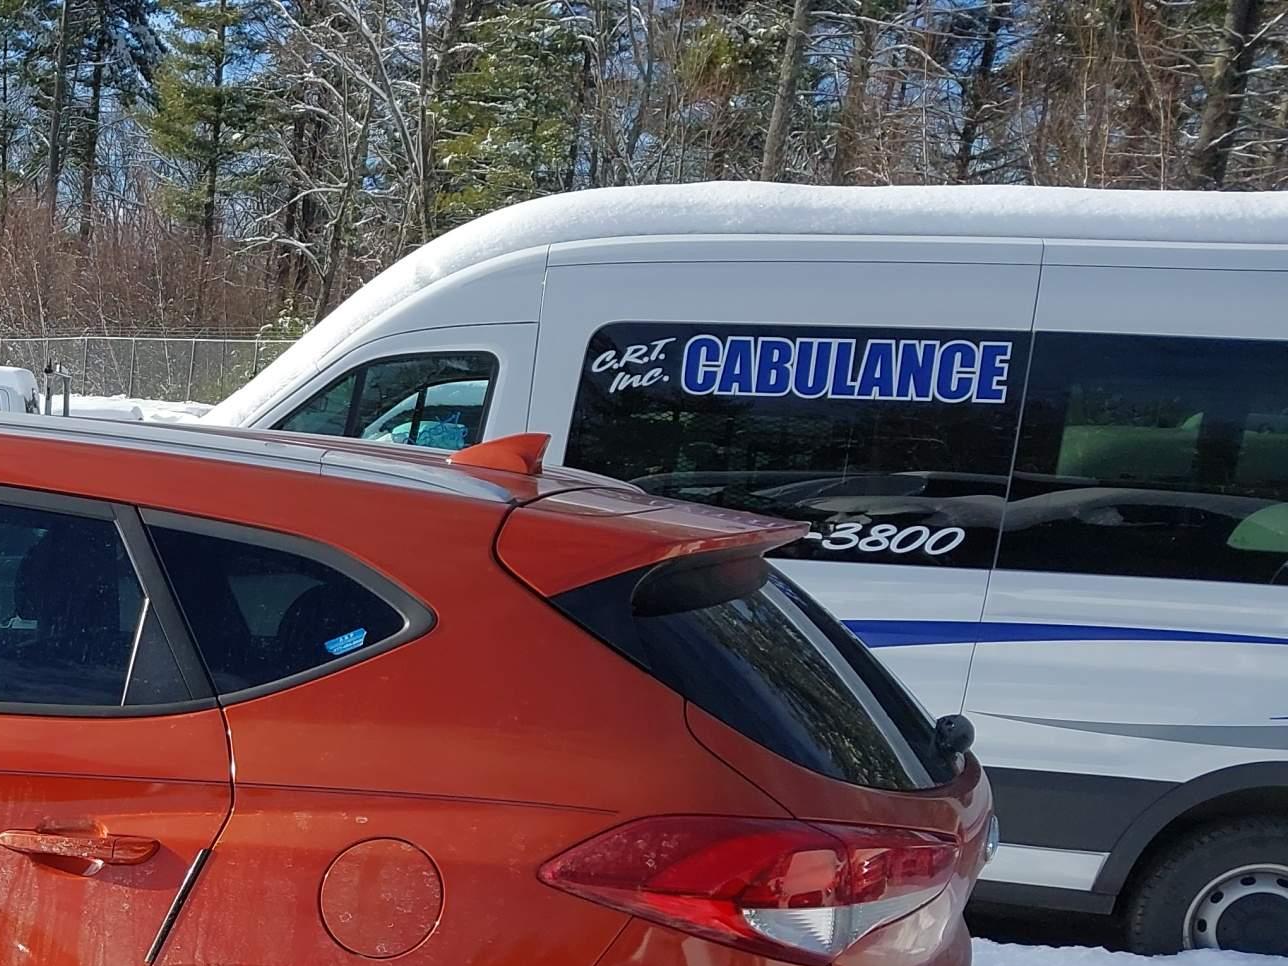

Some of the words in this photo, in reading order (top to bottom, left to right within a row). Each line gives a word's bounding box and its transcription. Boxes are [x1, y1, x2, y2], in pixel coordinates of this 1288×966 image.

[591, 337, 677, 373] C.R.T.
[680, 334, 1012, 403] CABULANCE
[608, 367, 670, 394] Inc.
